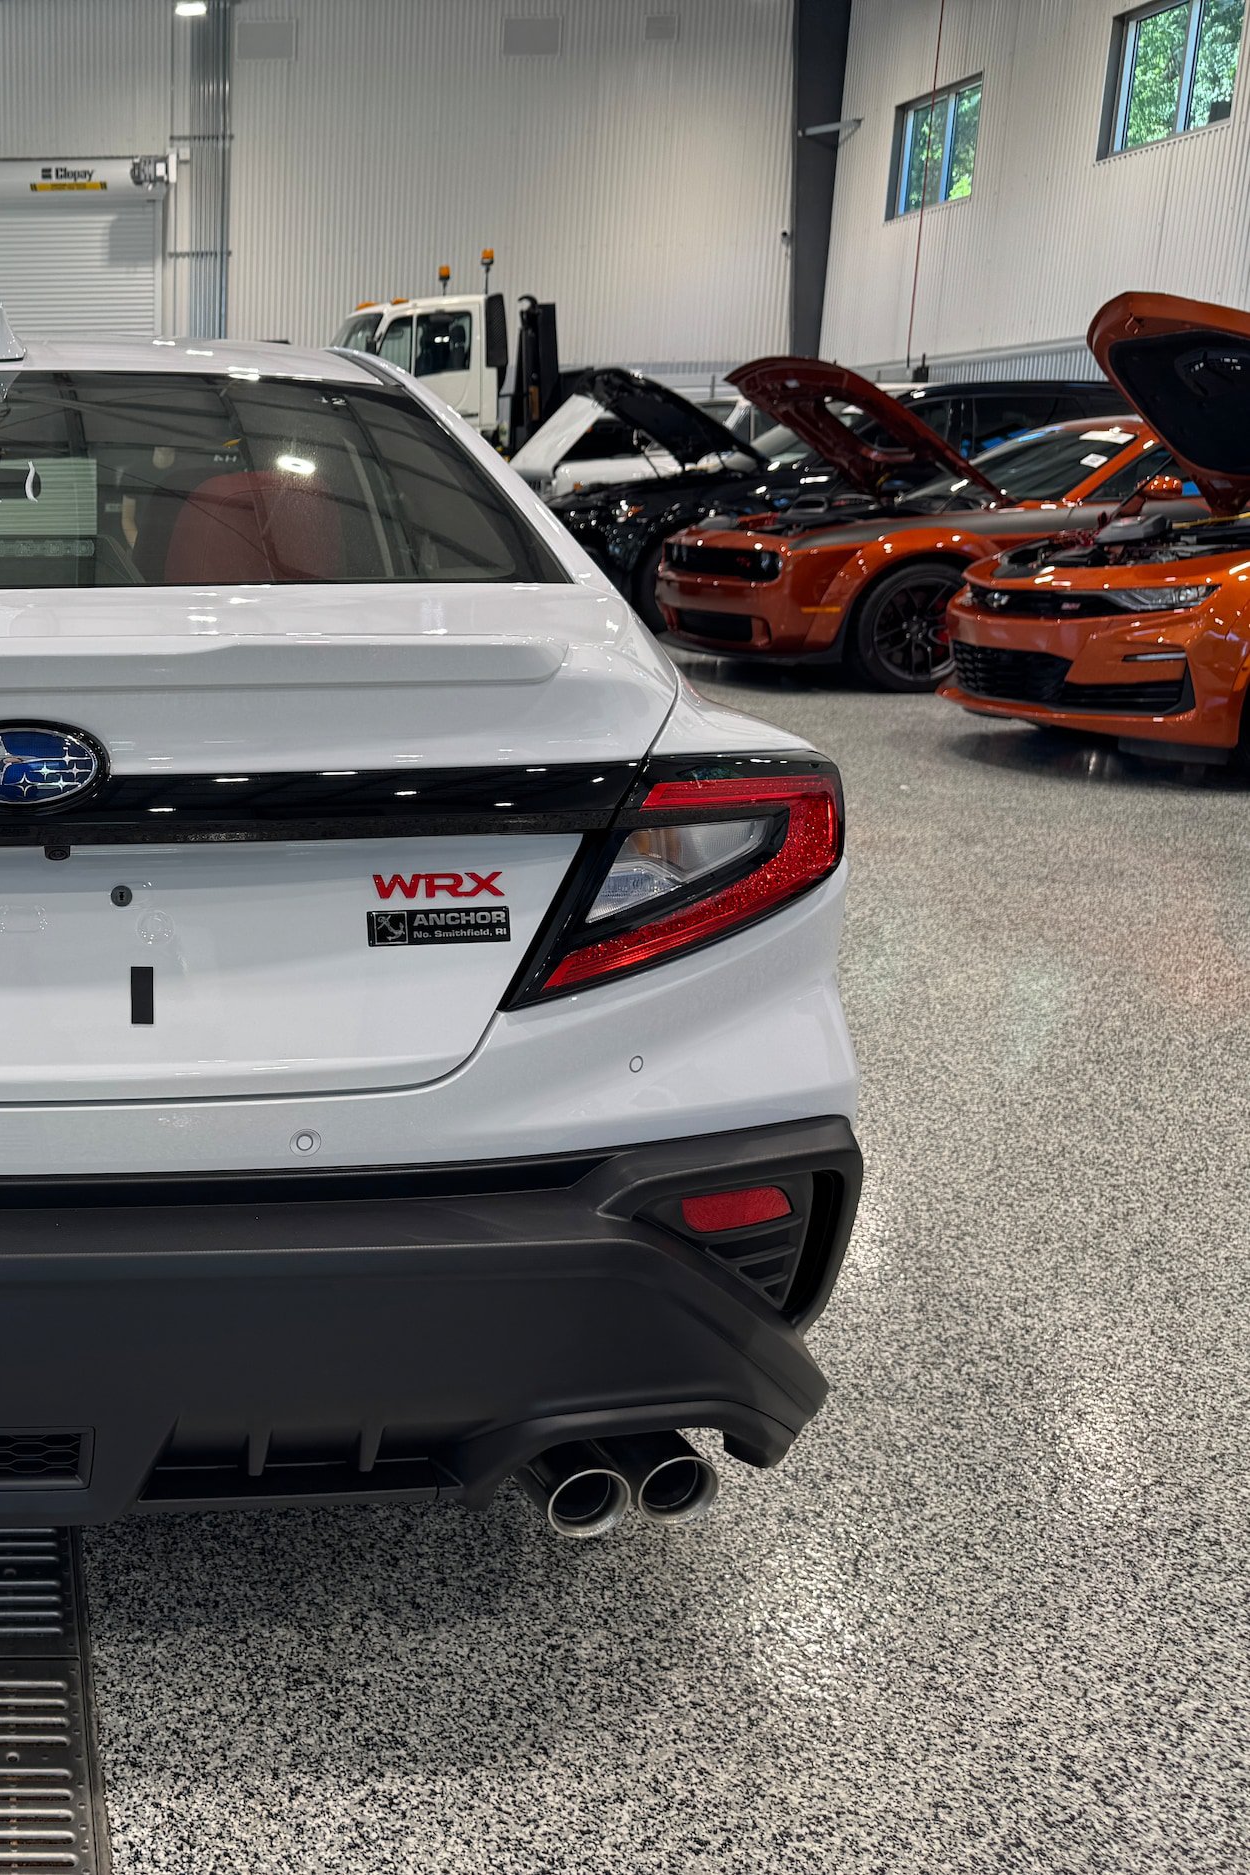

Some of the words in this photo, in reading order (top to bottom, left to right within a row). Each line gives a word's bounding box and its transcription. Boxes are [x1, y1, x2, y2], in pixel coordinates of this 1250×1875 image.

[55, 167, 95, 181] Clopay
[372, 871, 505, 899] WRX
[413, 911, 506, 926] ANCHOR
[413, 930, 432, 938] No.
[434, 928, 493, 938] Smithfield,
[495, 927, 507, 935] RI
